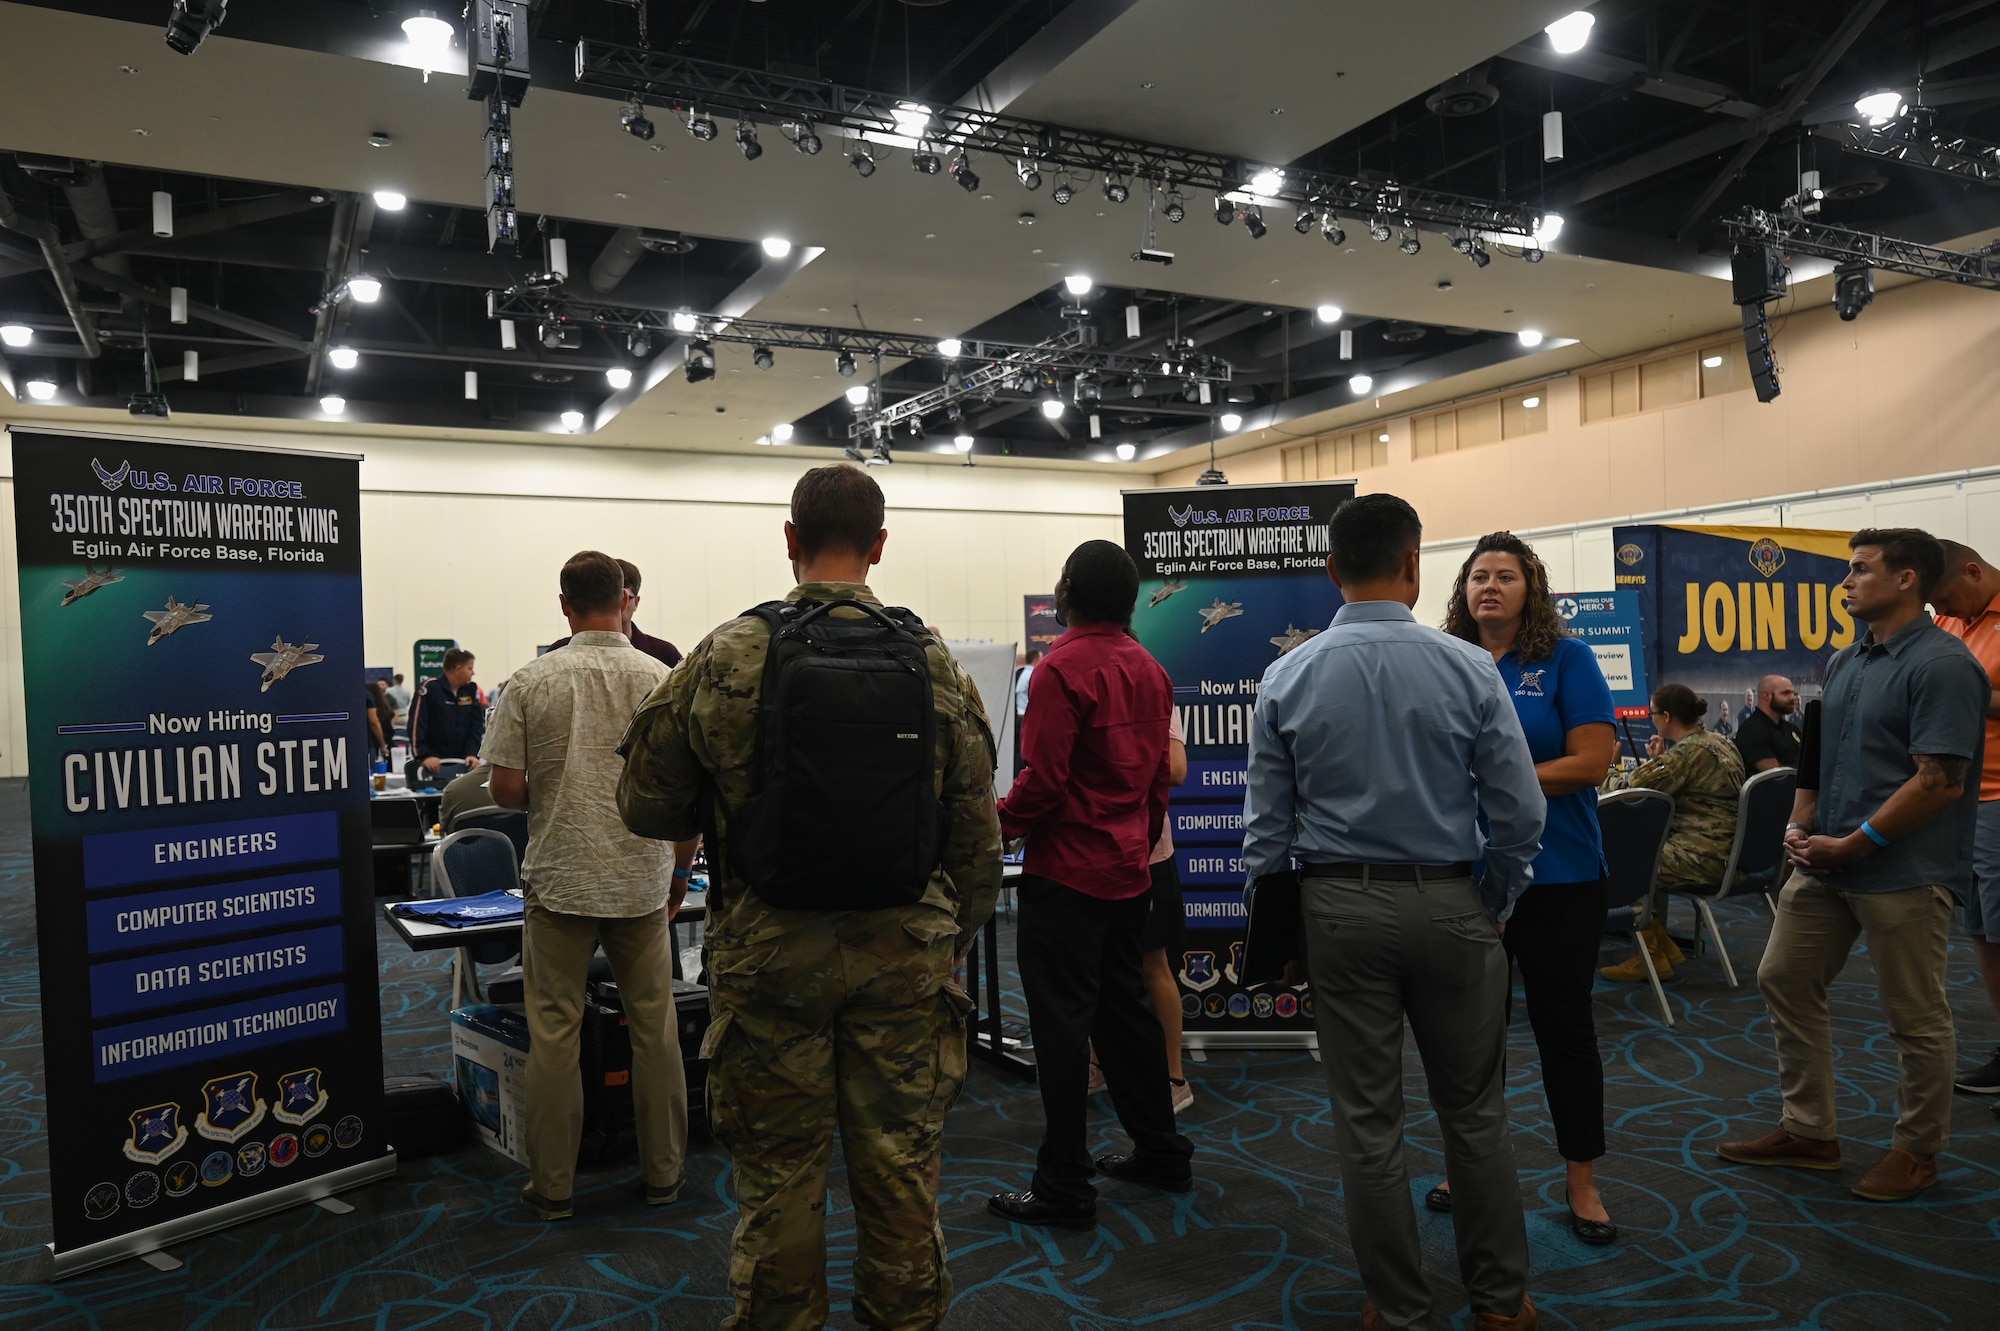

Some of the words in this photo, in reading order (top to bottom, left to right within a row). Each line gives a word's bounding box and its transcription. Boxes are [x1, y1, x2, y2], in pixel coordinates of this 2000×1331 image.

[130, 470, 177, 491] U.S.
[182, 474, 224, 494] AIR
[229, 477, 303, 499] FORCE
[50, 493, 114, 534] 350TH
[118, 497, 211, 538] SPECTRUM
[215, 502, 294, 542] WARFARE
[297, 507, 339, 544] WING
[1191, 510, 1222, 524] U.S.
[1225, 508, 1254, 523] AIR
[1257, 506, 1310, 521] FORCE
[72, 540, 122, 559] Eglin
[127, 542, 154, 557] Air
[159, 543, 211, 558] Force
[216, 545, 263, 563] Base,
[267, 547, 325, 562] Florida
[1143, 530, 1181, 559] 350TH
[1184, 527, 1244, 557] SPECTRUM
[1246, 525, 1303, 555] WARFARE
[1305, 524, 1330, 553] WIN
[1156, 561, 1186, 575] Eglin
[1188, 560, 1207, 572] Air
[1209, 560, 1244, 571] Force
[1247, 558, 1280, 570] Base,
[1283, 556, 1326, 568] Florida
[1616, 575, 1647, 584] BENEFITS
[1677, 581, 1786, 655] JOIN
[1797, 582, 1856, 651] US
[1588, 626, 1632, 636] SUMMIT
[1201, 680, 1235, 696] Now
[1239, 679, 1261, 695] Hir
[150, 713, 201, 734] Now
[208, 709, 272, 734] Hiring
[1175, 704, 1255, 745] VILIA
[64, 743, 241, 813] CIVILIAN
[256, 737, 348, 795] STEM
[1202, 770, 1248, 786] ENGIN
[1177, 814, 1243, 830] COMPUTER
[154, 831, 277, 864] ENGINEERS
[1188, 858, 1224, 873] DATA
[116, 900, 217, 933] COMPUTER
[222, 885, 316, 918] SCIENTISTS
[1183, 902, 1248, 917] ORMATION
[135, 965, 191, 994] DATA
[198, 945, 307, 982] SCIENTISTS
[101, 1021, 228, 1066] INFORMATION
[232, 998, 338, 1038] TECHNOLOGY
